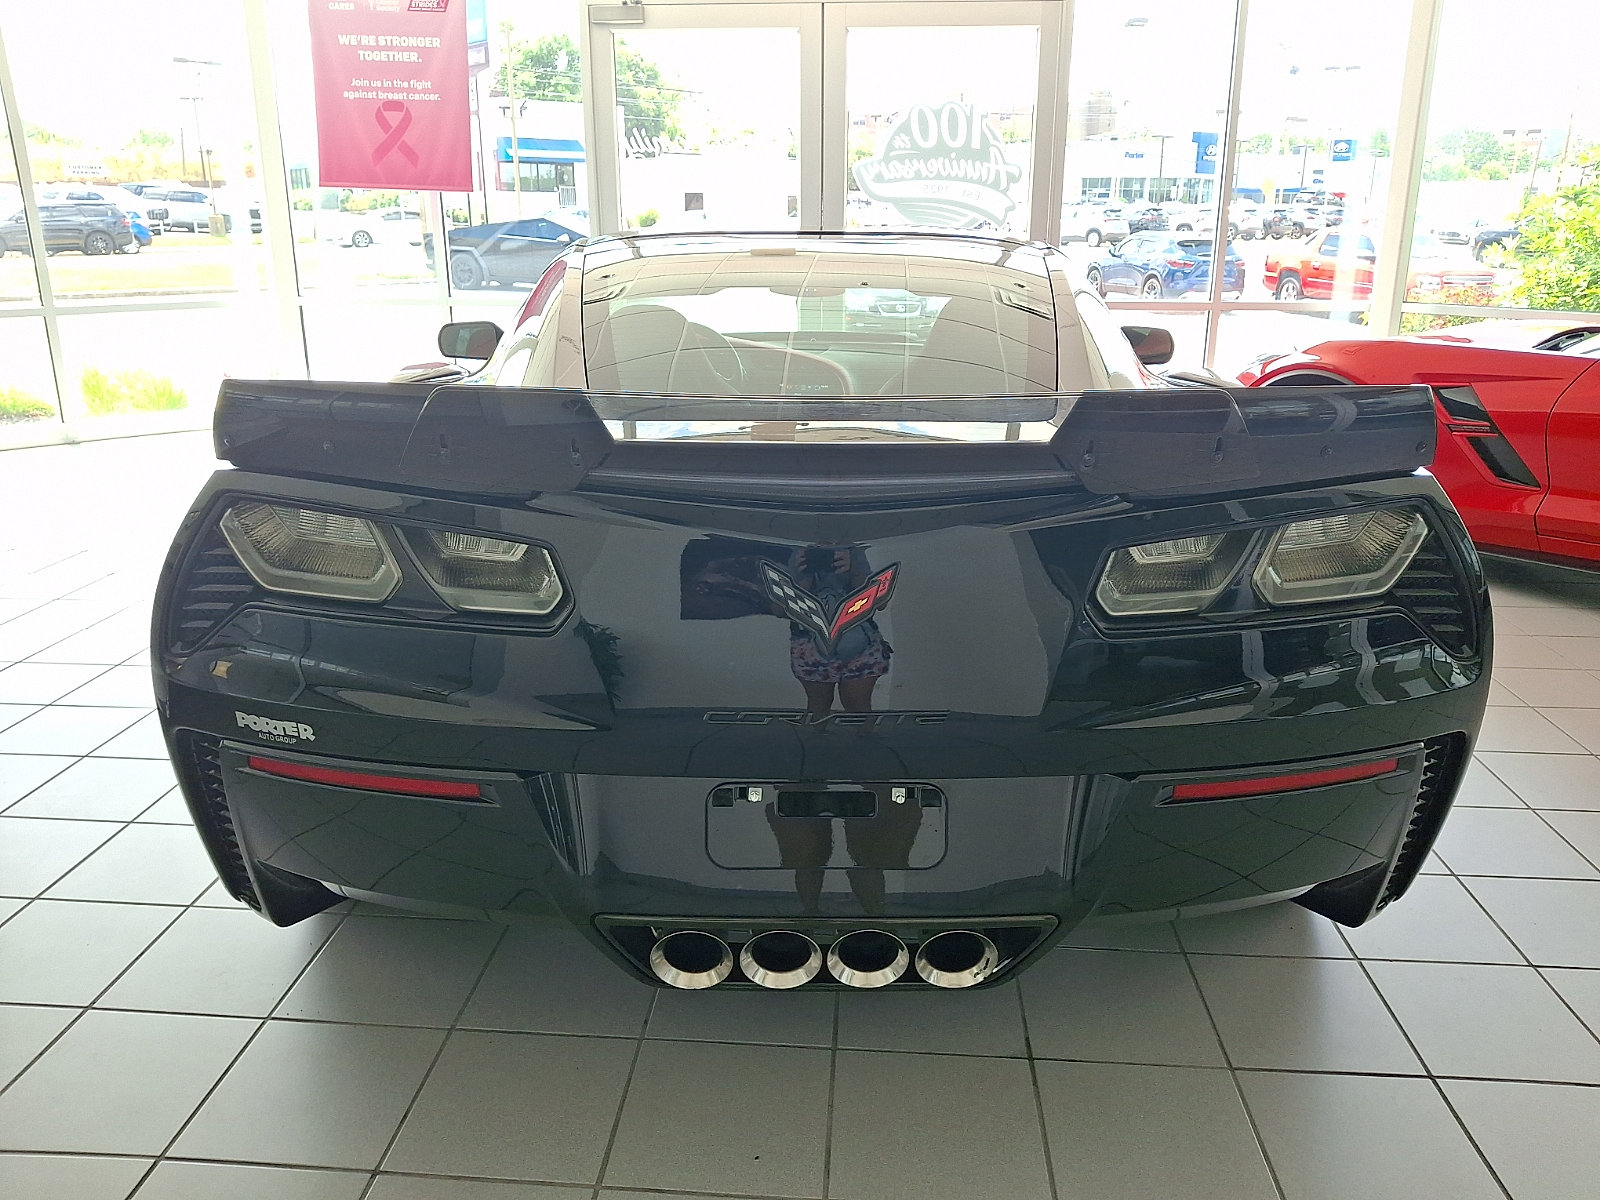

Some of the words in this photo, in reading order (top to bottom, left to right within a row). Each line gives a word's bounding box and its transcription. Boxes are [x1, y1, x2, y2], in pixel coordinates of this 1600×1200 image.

[328, 2, 355, 11] CARES
[338, 34, 377, 46] WE'RE
[378, 35, 441, 48] STRONGER
[358, 50, 422, 63] TOGETHER.
[351, 78, 370, 88] Join
[371, 80, 382, 88] us
[383, 79, 392, 88] in
[393, 79, 409, 89] the
[410, 79, 432, 90] fight
[343, 90, 377, 100] against
[378, 90, 408, 100] breast
[409, 92, 441, 101] cancer.
[702, 710, 951, 726] CORVETTE
[235, 710, 316, 742] PORTER
[258, 732, 275, 742] AUTO
[275, 734, 297, 745] GROUP
